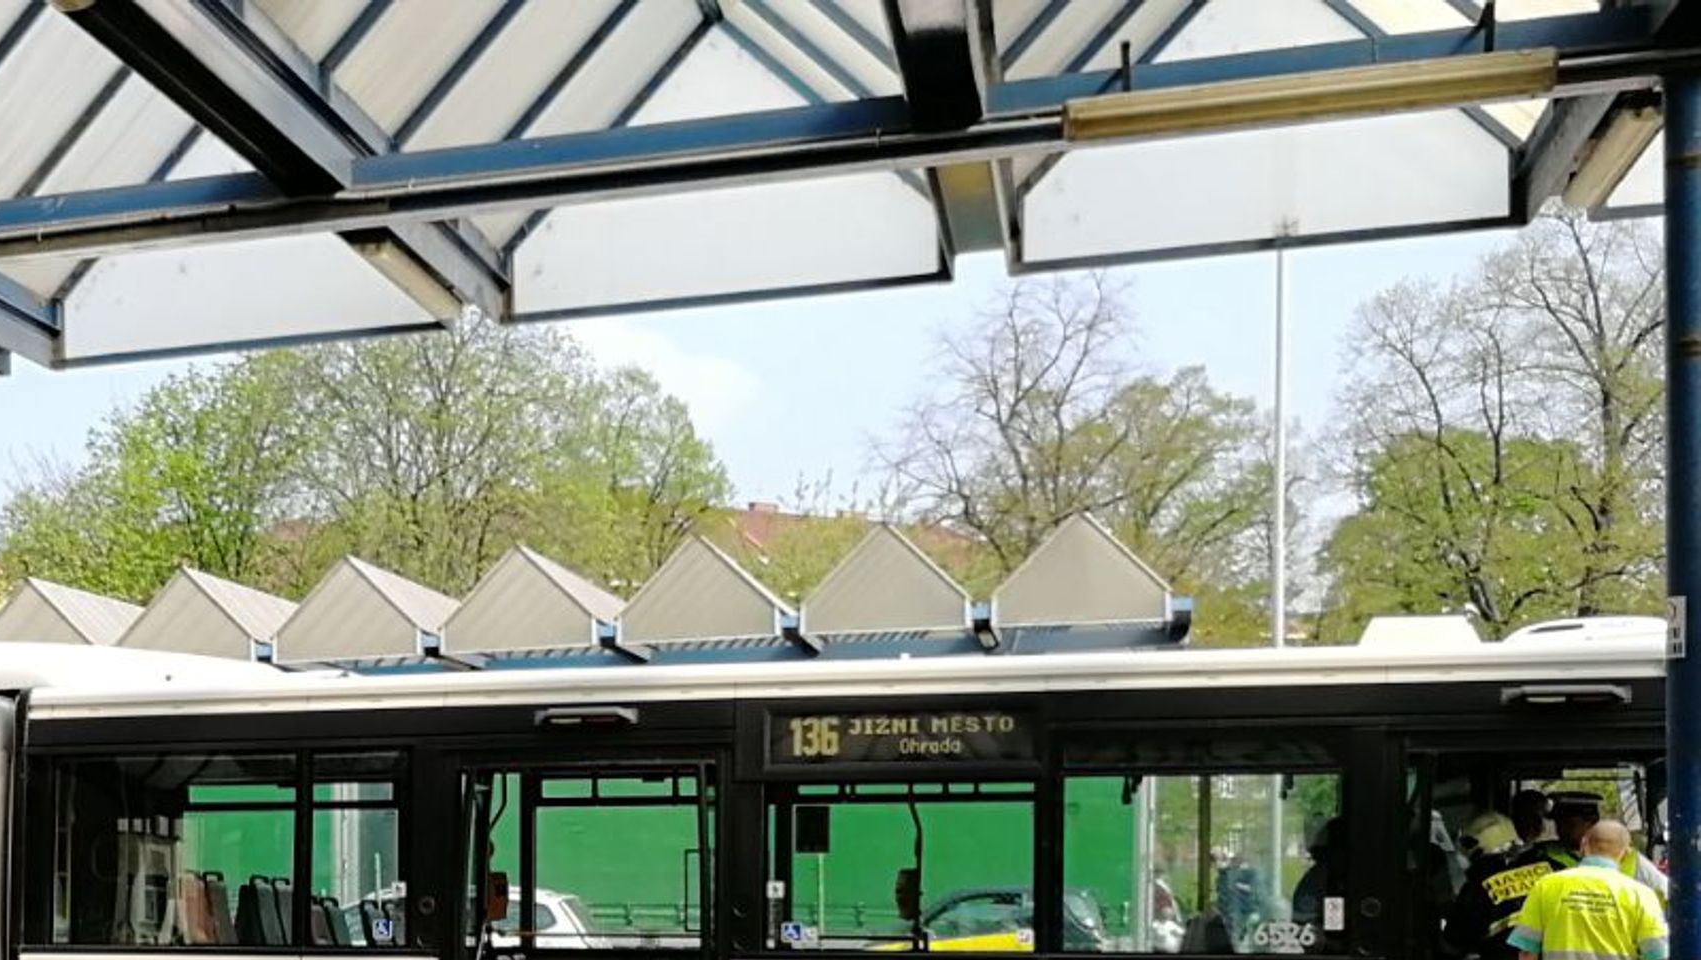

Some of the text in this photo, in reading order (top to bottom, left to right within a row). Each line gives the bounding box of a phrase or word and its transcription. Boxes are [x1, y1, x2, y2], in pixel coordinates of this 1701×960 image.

[789, 716, 840, 757] 136
[899, 738, 961, 754] Ohrada
[1254, 921, 1316, 946] 6526
